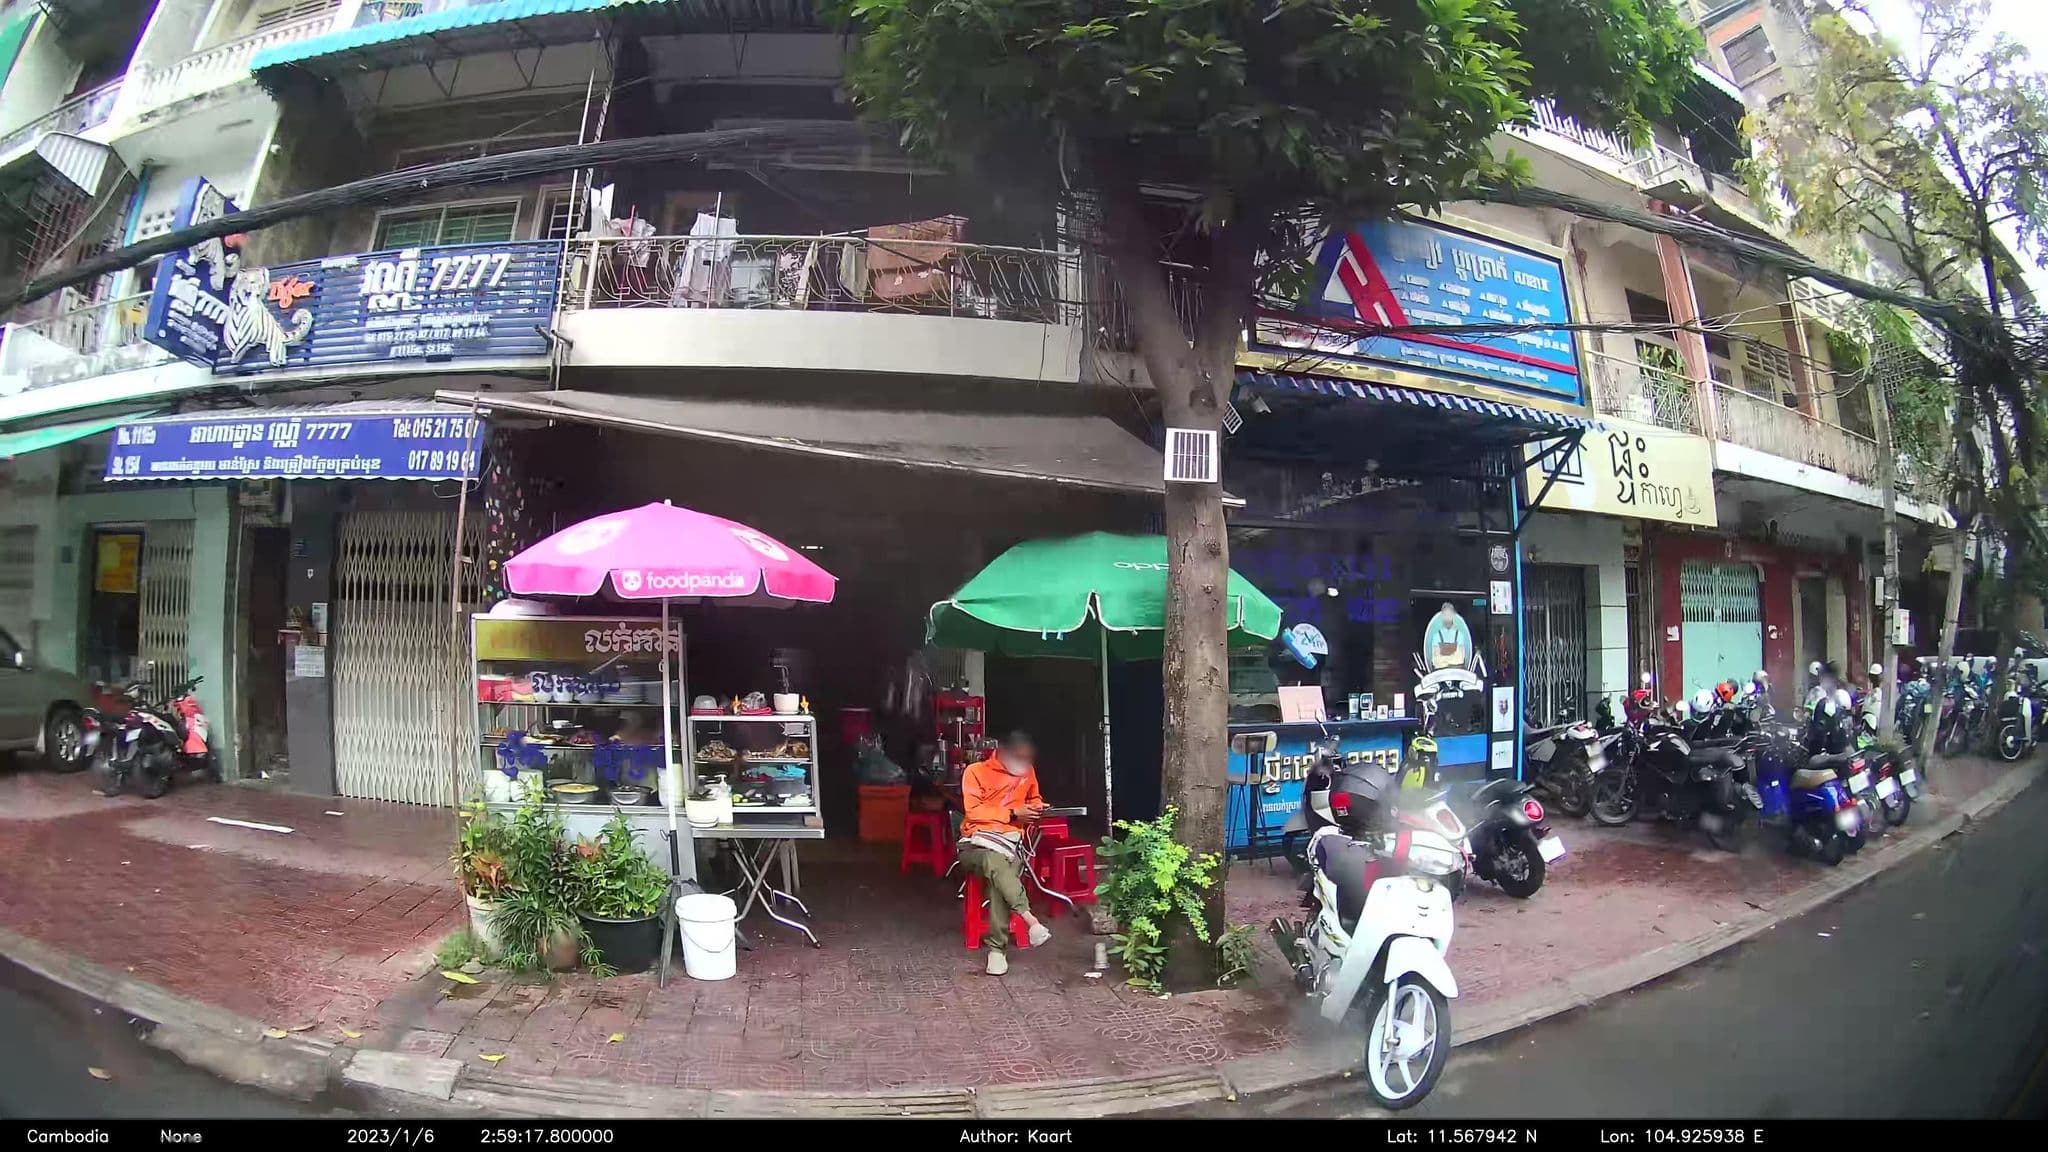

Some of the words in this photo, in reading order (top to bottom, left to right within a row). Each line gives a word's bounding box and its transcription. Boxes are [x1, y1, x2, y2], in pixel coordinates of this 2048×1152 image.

[429, 253, 511, 291] 7777
[306, 423, 352, 440] 7777
[413, 419, 432, 438] 015
[434, 419, 447, 438] 21
[449, 419, 464, 438] 75
[408, 450, 427, 470] 017
[429, 451, 444, 470] 89
[446, 451, 459, 470] 19
[1113, 561, 1169, 571] opp
[646, 571, 745, 592] foodpanda
